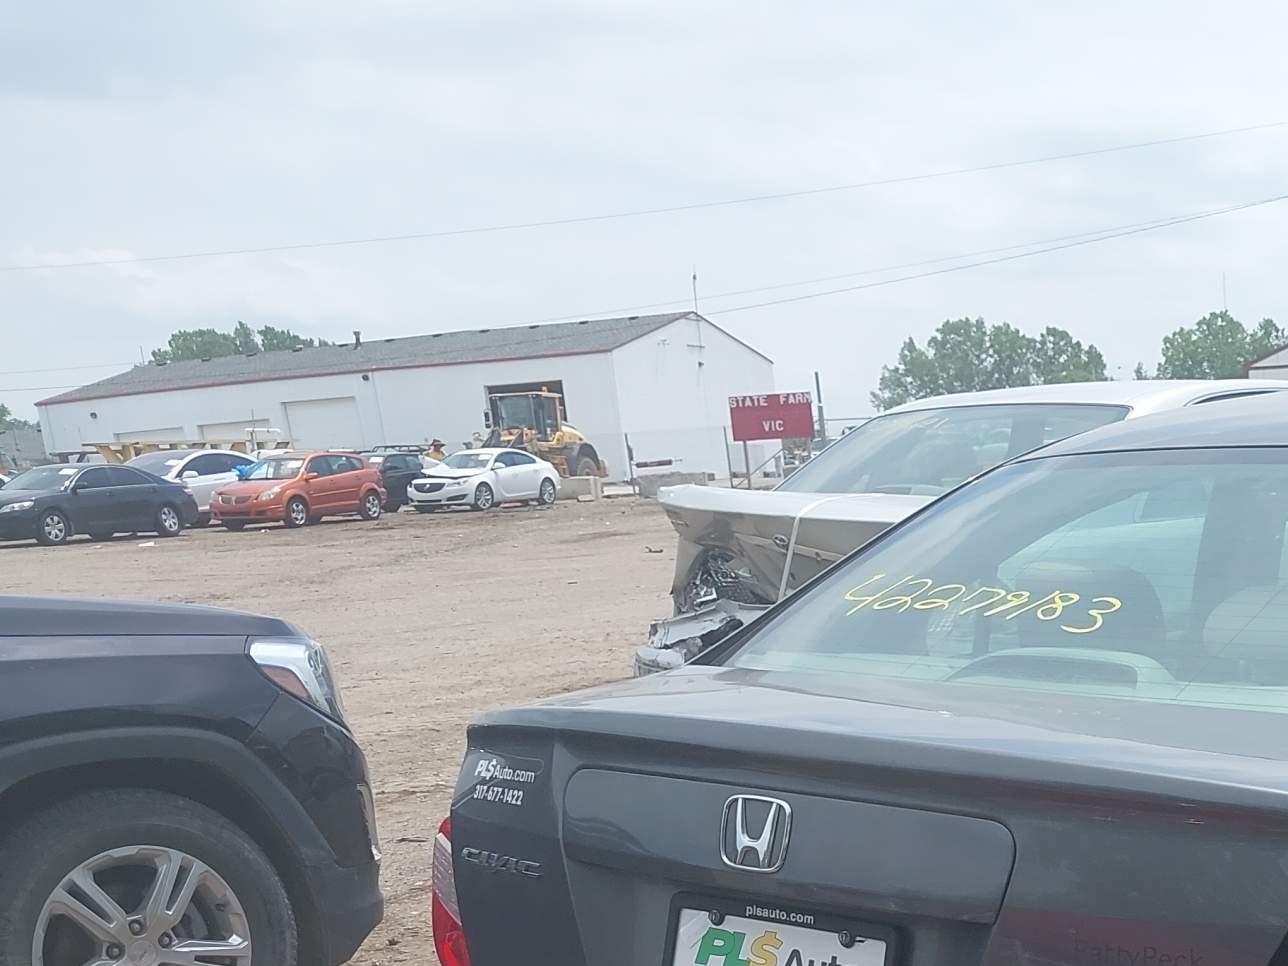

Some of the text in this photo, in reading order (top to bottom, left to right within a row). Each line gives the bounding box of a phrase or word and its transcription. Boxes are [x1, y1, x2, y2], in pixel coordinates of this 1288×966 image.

[728, 395, 769, 409] STATE
[762, 420, 784, 432] VIC
[844, 573, 1123, 634] 42279183
[473, 784, 525, 806] 317-677-1422
[461, 847, 543, 879] CIVIC
[745, 904, 815, 925] plsauto.com
